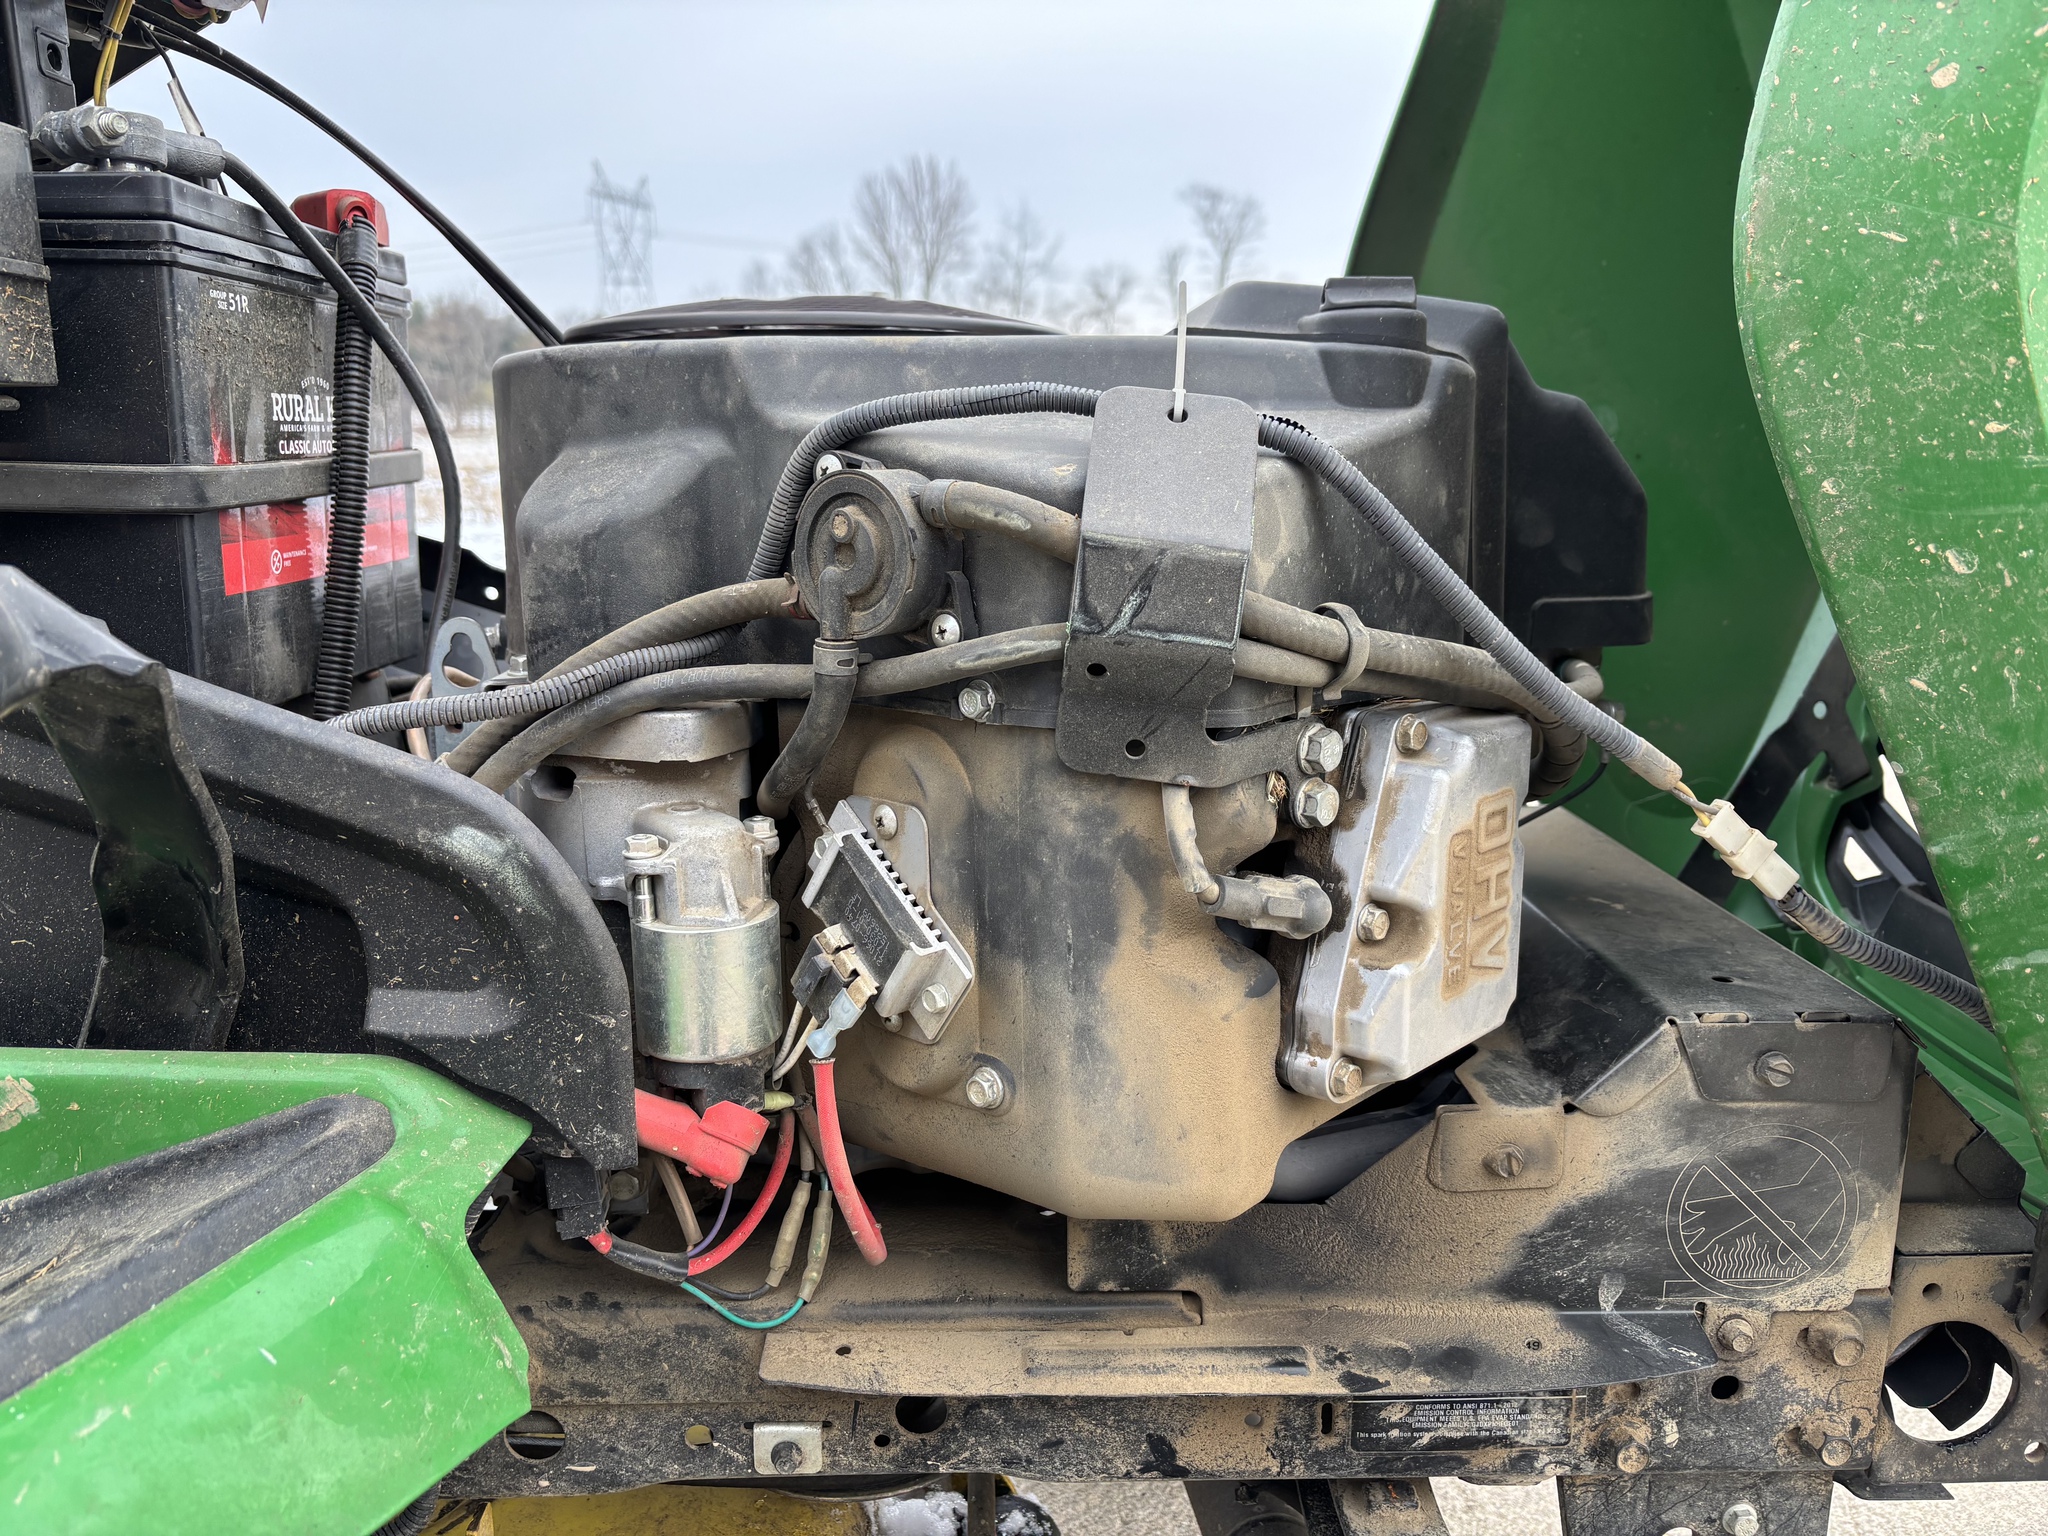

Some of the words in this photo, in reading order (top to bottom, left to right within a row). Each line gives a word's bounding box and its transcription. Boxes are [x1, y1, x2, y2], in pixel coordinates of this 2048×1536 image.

[210, 289, 227, 300] GROUP
[217, 300, 228, 310] SIZE
[228, 293, 250, 313] 51R
[271, 393, 324, 422] RURAL
[279, 440, 311, 455] CLASSIC
[1470, 789, 1516, 970] OHV
[1415, 1403, 1451, 1411] CONFORMS
[1402, 1415, 1437, 1423] EQUIPMENT
[1411, 1421, 1442, 1429] EMISSION
[1370, 1432, 1387, 1440] spark
